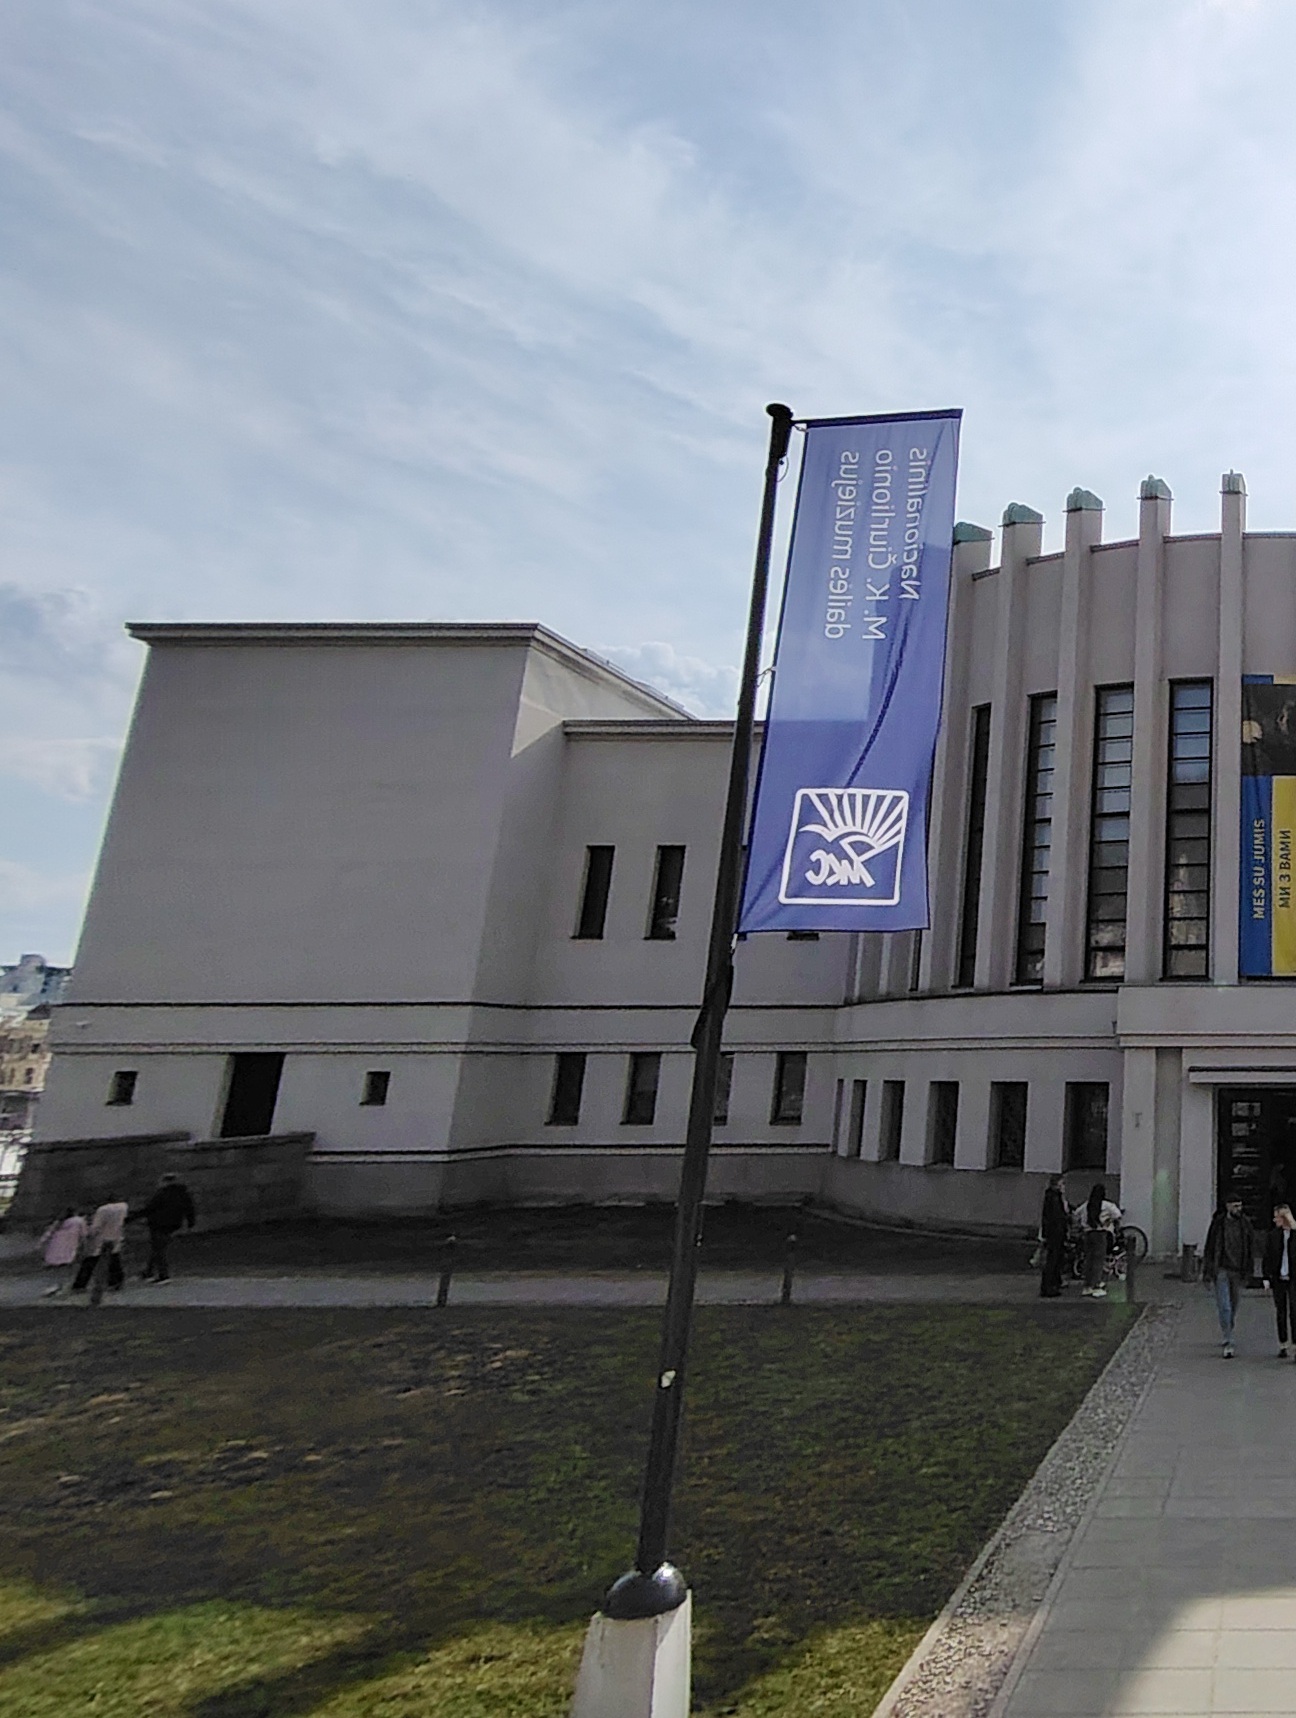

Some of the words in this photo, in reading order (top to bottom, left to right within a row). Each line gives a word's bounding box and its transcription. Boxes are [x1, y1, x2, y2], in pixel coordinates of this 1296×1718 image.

[1253, 818, 1265, 863] JUMIS
[1279, 830, 1291, 870] ВАМИ
[1252, 866, 1265, 886] SU
[1252, 888, 1265, 919] MES
[1278, 886, 1291, 909] МИ
